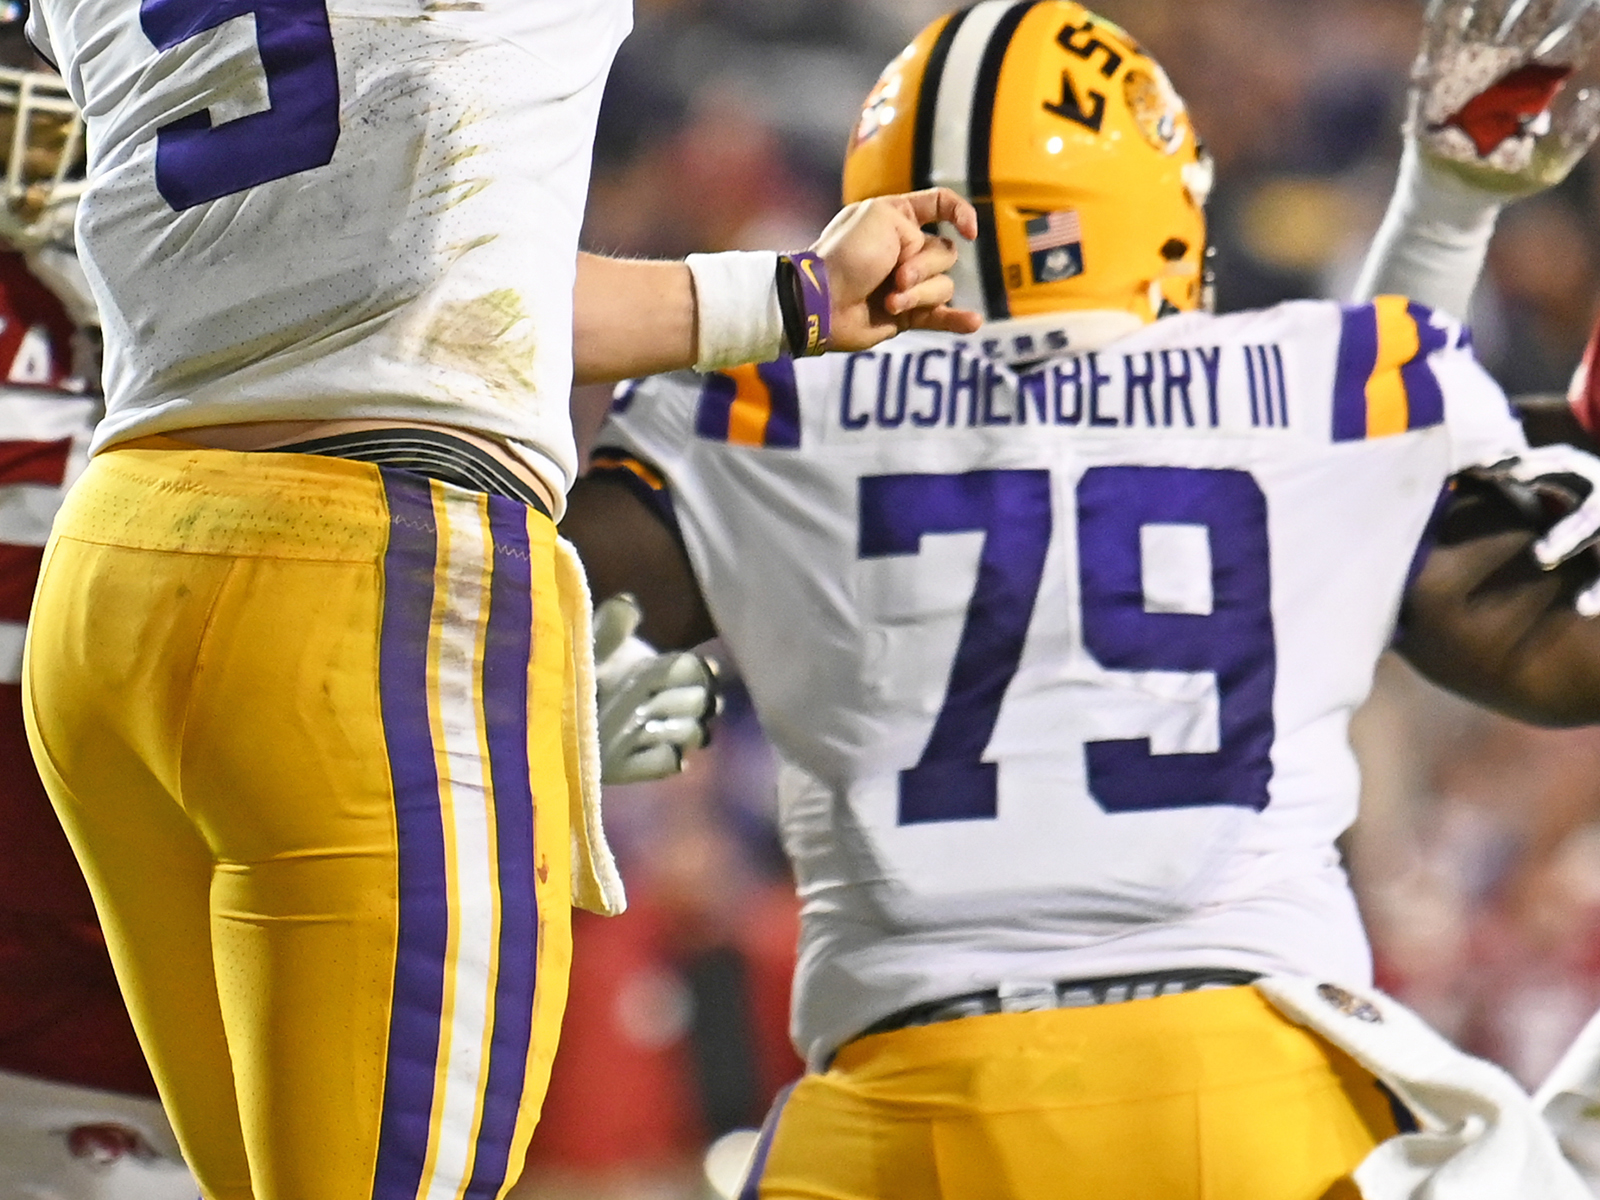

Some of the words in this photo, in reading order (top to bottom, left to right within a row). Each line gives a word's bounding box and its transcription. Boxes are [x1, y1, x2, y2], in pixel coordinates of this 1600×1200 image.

[838, 345, 1221, 430] CUSHENBERRY
[1244, 344, 1289, 428] III
[857, 464, 1276, 826] 79
